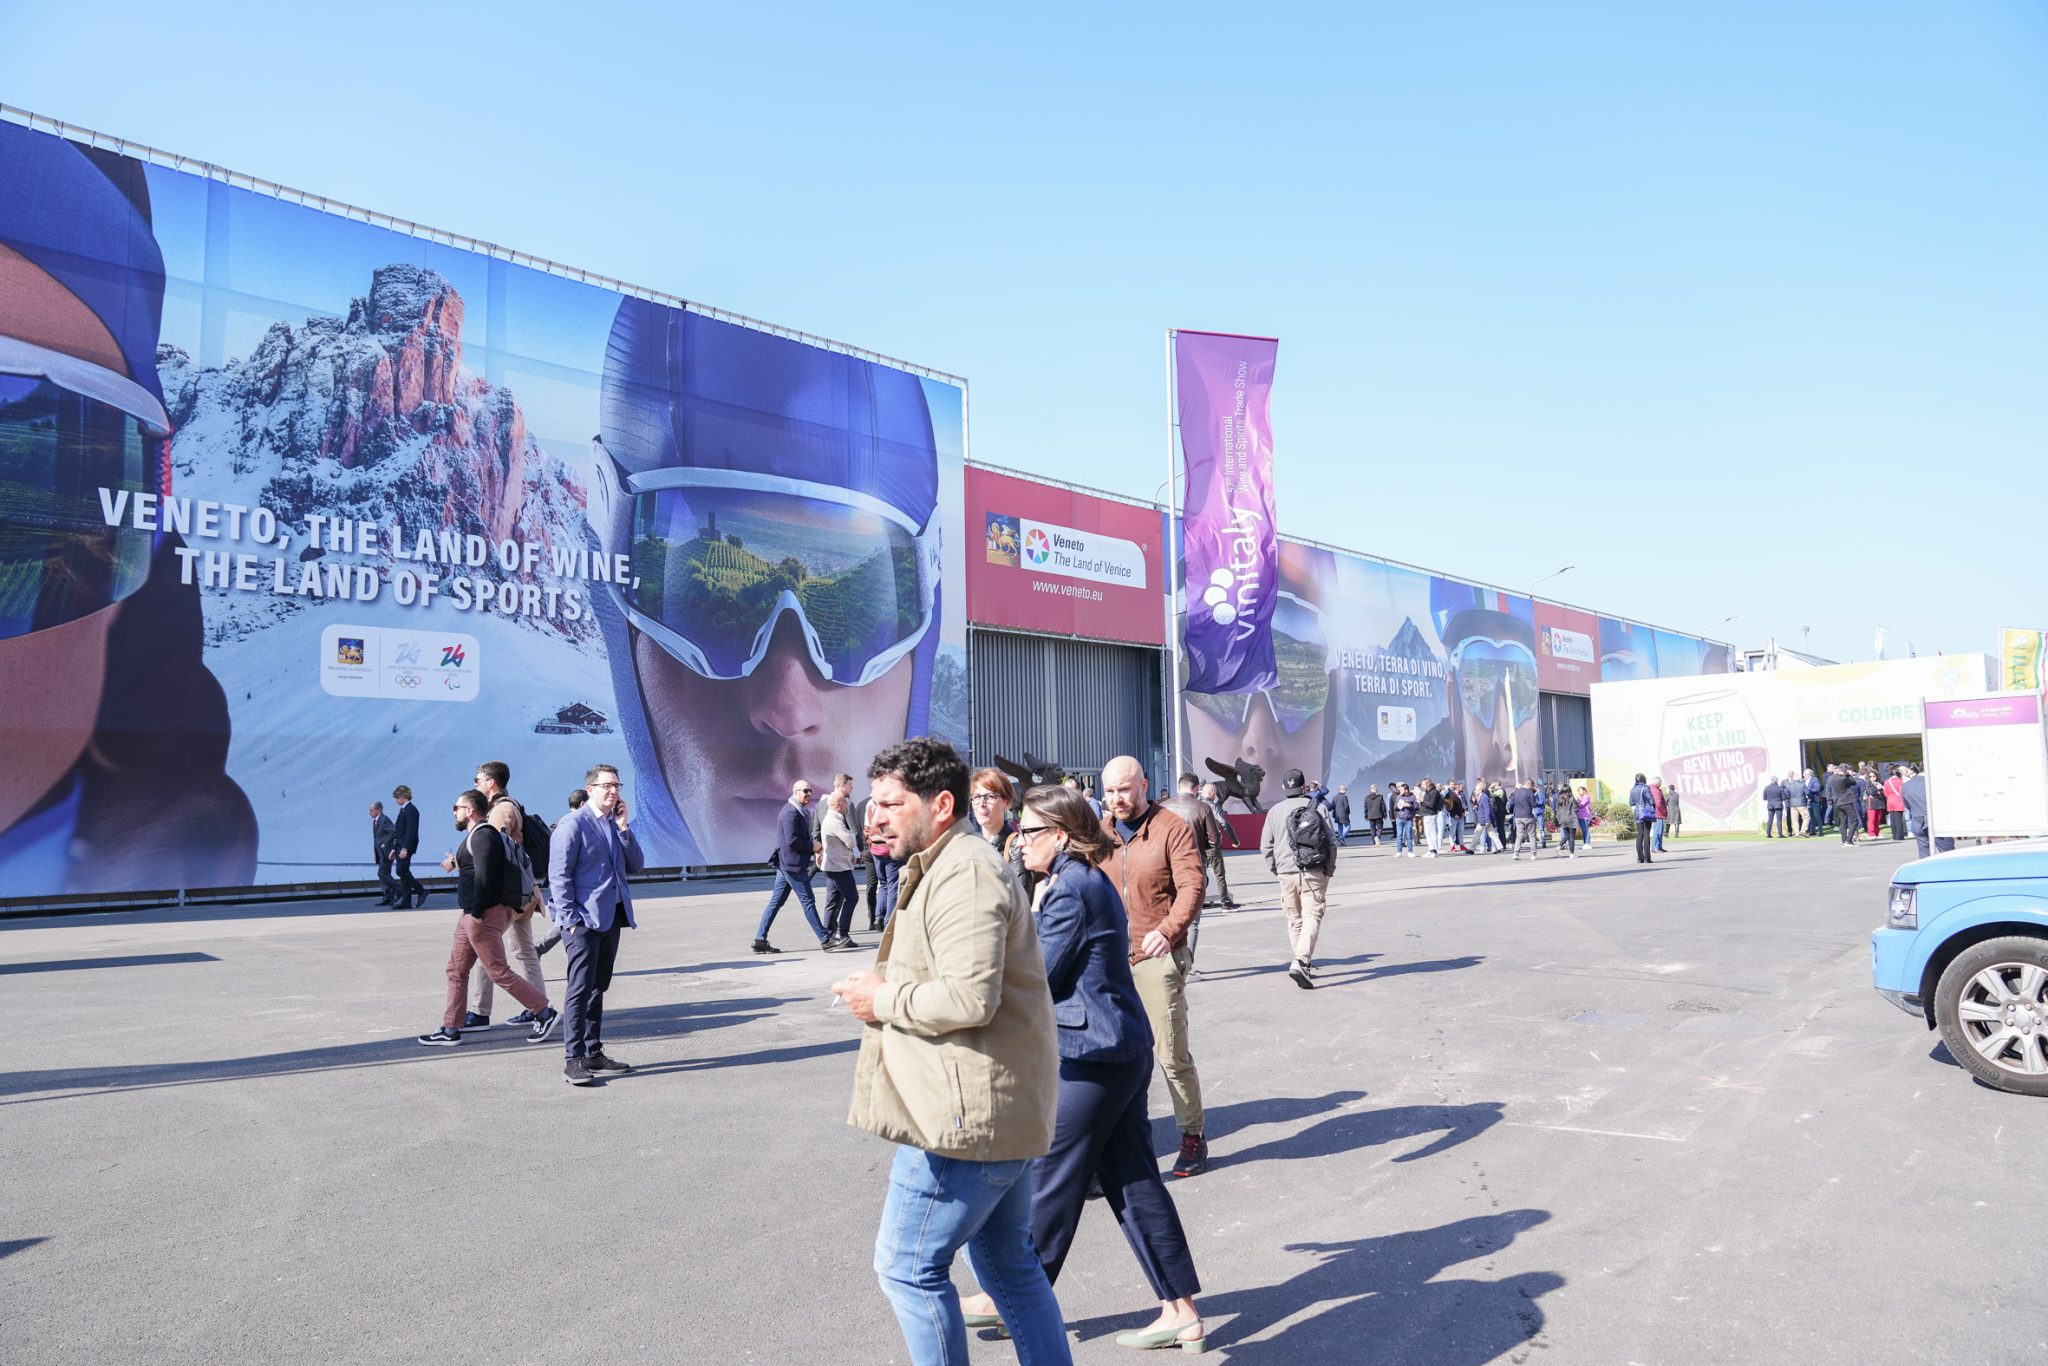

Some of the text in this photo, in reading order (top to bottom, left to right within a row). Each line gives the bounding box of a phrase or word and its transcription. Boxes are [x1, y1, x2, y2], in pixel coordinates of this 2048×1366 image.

[1234, 360, 1249, 494] Wine and Spirits Trade Show
[1221, 416, 1235, 475] International
[98, 487, 641, 590] VENETO, THE LAND OF WINE,
[1053, 533, 1085, 552] Veneto
[1054, 551, 1132, 578] The Land of Venice
[174, 547, 592, 621] THE LAND OF SPORTS.
[1033, 581, 1103, 601] www.veneto.eu
[1336, 649, 1446, 680] VENETO, TERRA DI VINO,
[1354, 674, 1433, 698] TERRA DI SPORT.
[1686, 712, 1723, 732] KEEP
[1672, 729, 1747, 756] CALM AND
[1682, 750, 1745, 774] BEVI VINO
[1676, 763, 1755, 795] ITALIANO
